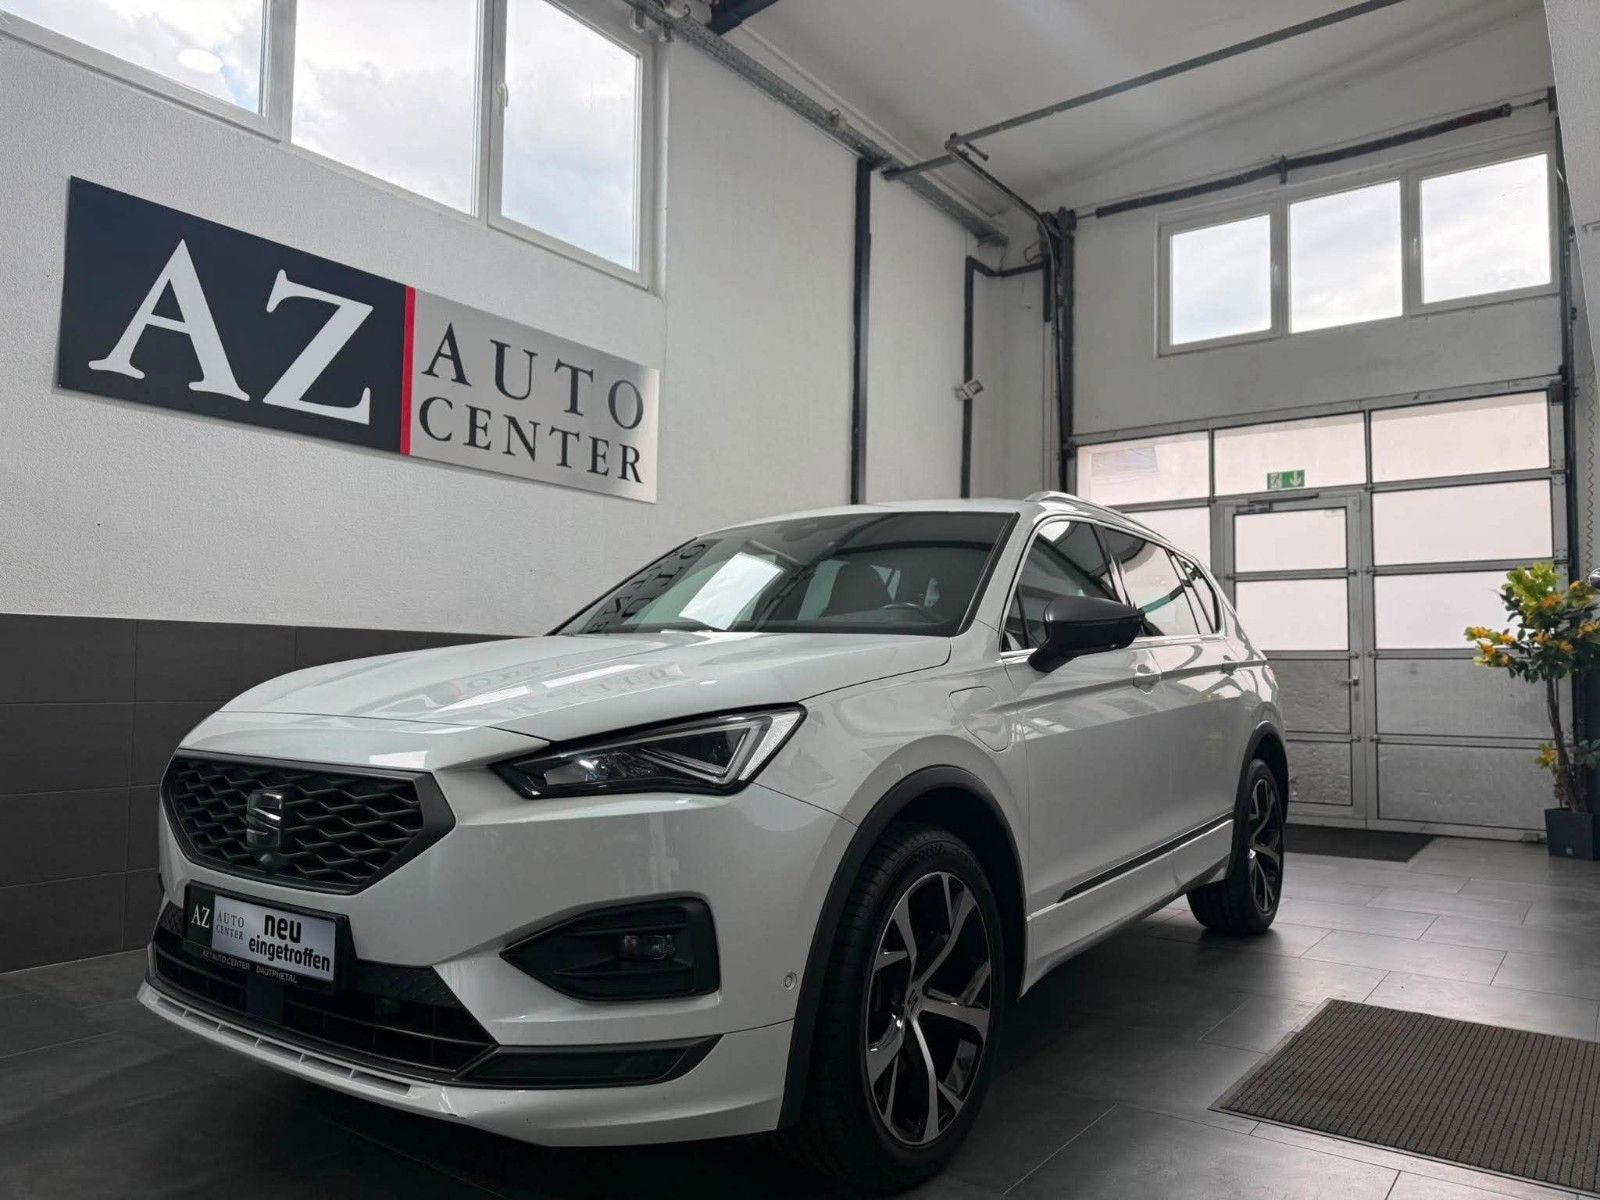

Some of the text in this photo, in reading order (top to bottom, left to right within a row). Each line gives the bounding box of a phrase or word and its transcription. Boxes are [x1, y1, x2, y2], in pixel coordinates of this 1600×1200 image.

[88, 238, 374, 425] AZ
[421, 322, 645, 430] AUTO
[418, 396, 644, 484] CENTER
[191, 904, 210, 929] AZ
[216, 911, 245, 928] AUTO
[216, 924, 244, 940] CENTER
[264, 914, 302, 943] neu
[249, 935, 330, 971] eingetroffen
